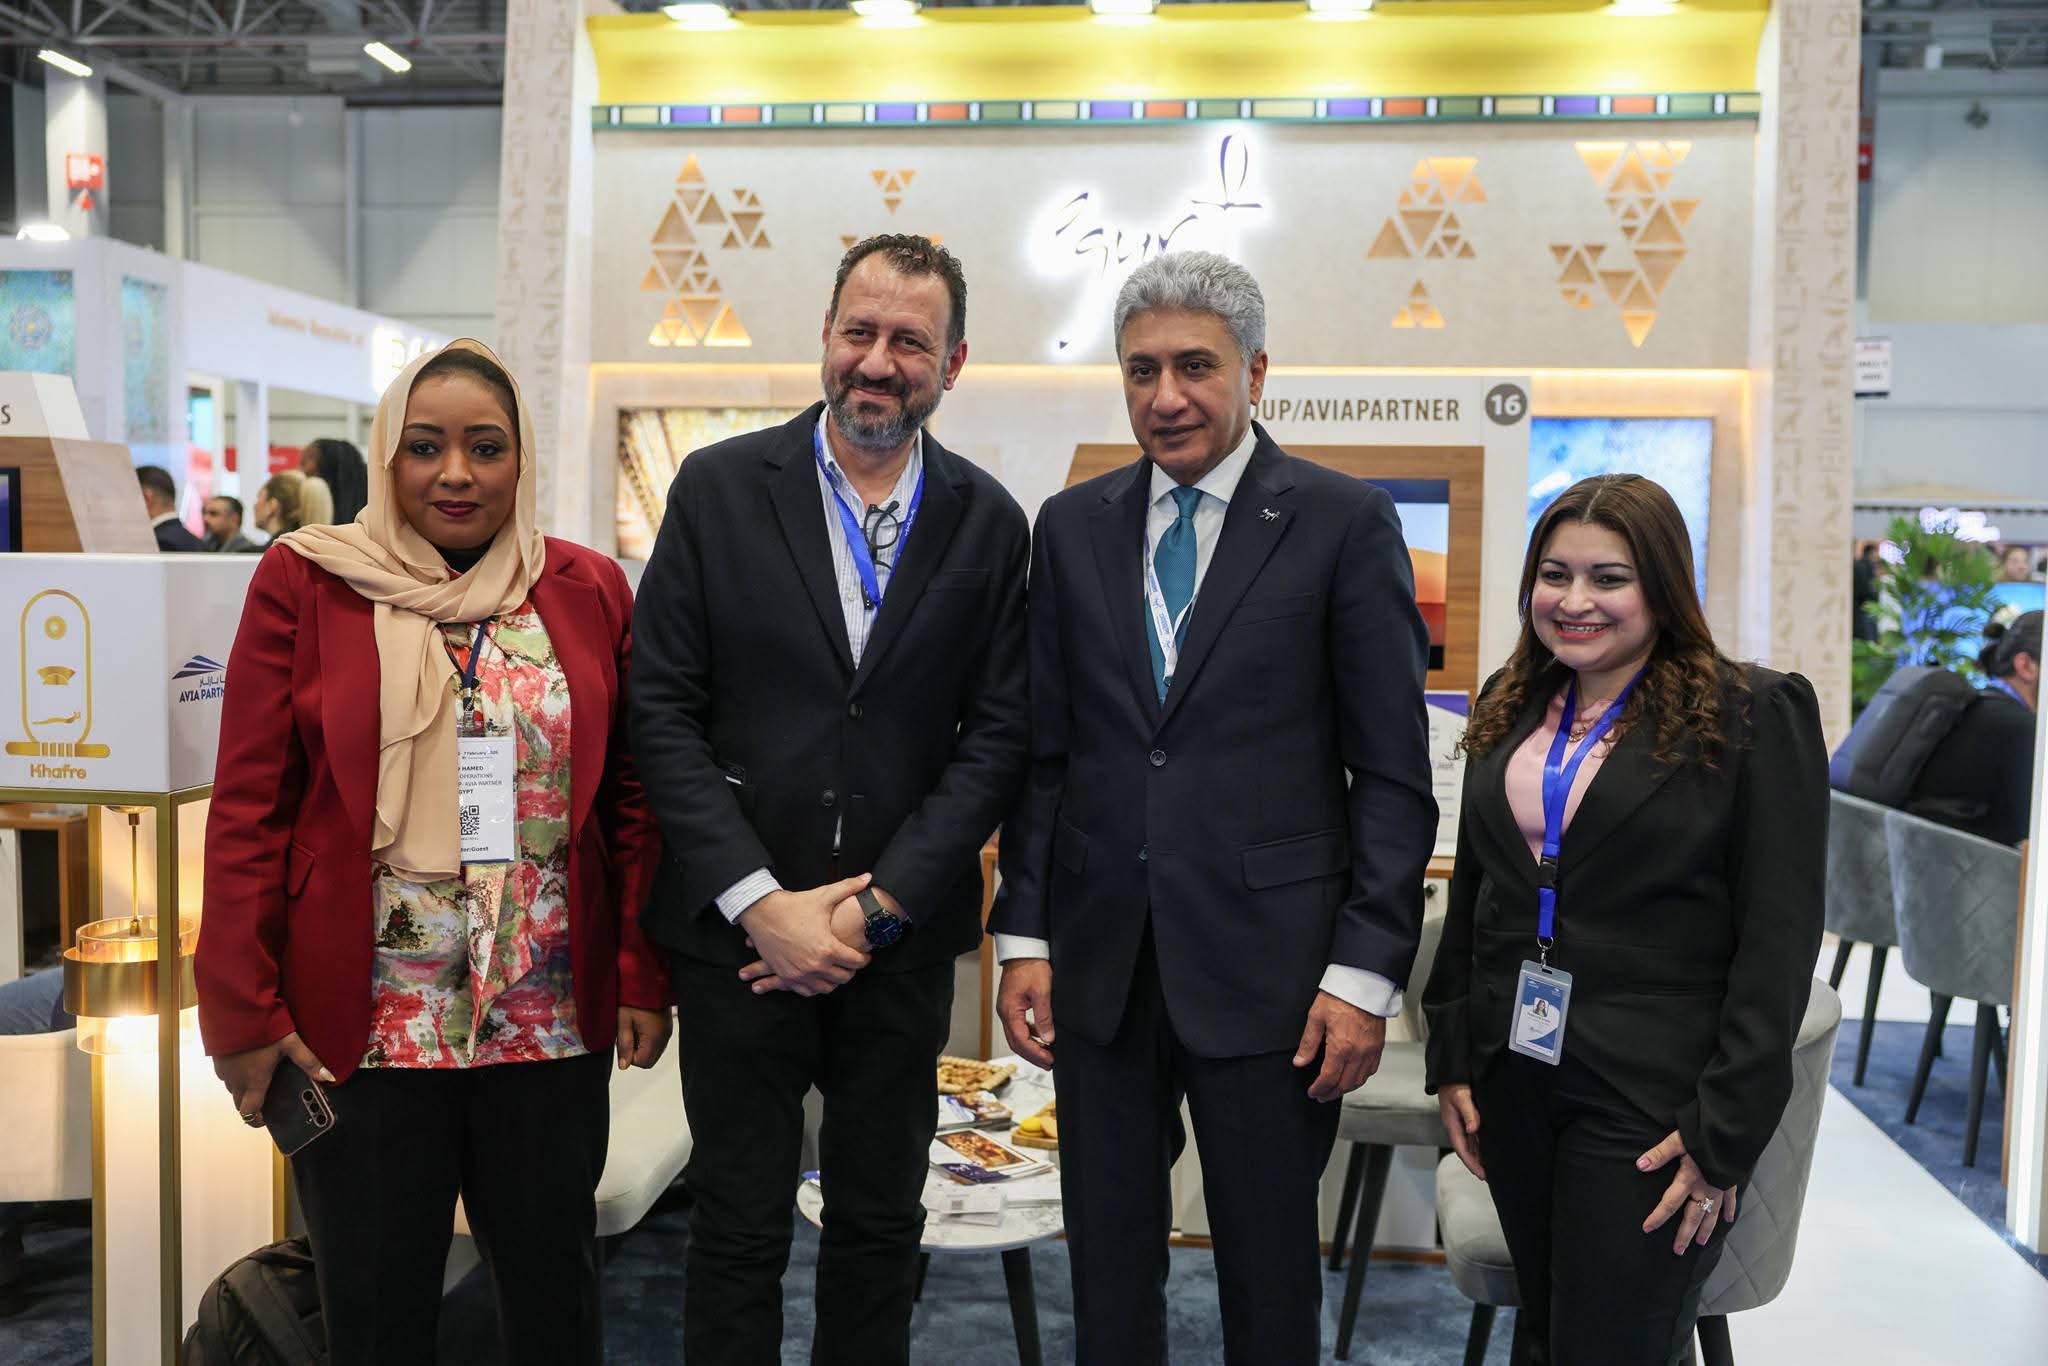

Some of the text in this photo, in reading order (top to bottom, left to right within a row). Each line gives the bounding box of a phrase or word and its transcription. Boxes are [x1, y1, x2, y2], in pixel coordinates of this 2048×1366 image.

[1490, 393, 1522, 417] 16
[179, 687, 225, 703] AVIA PARTN
[30, 763, 87, 779] Khafre
